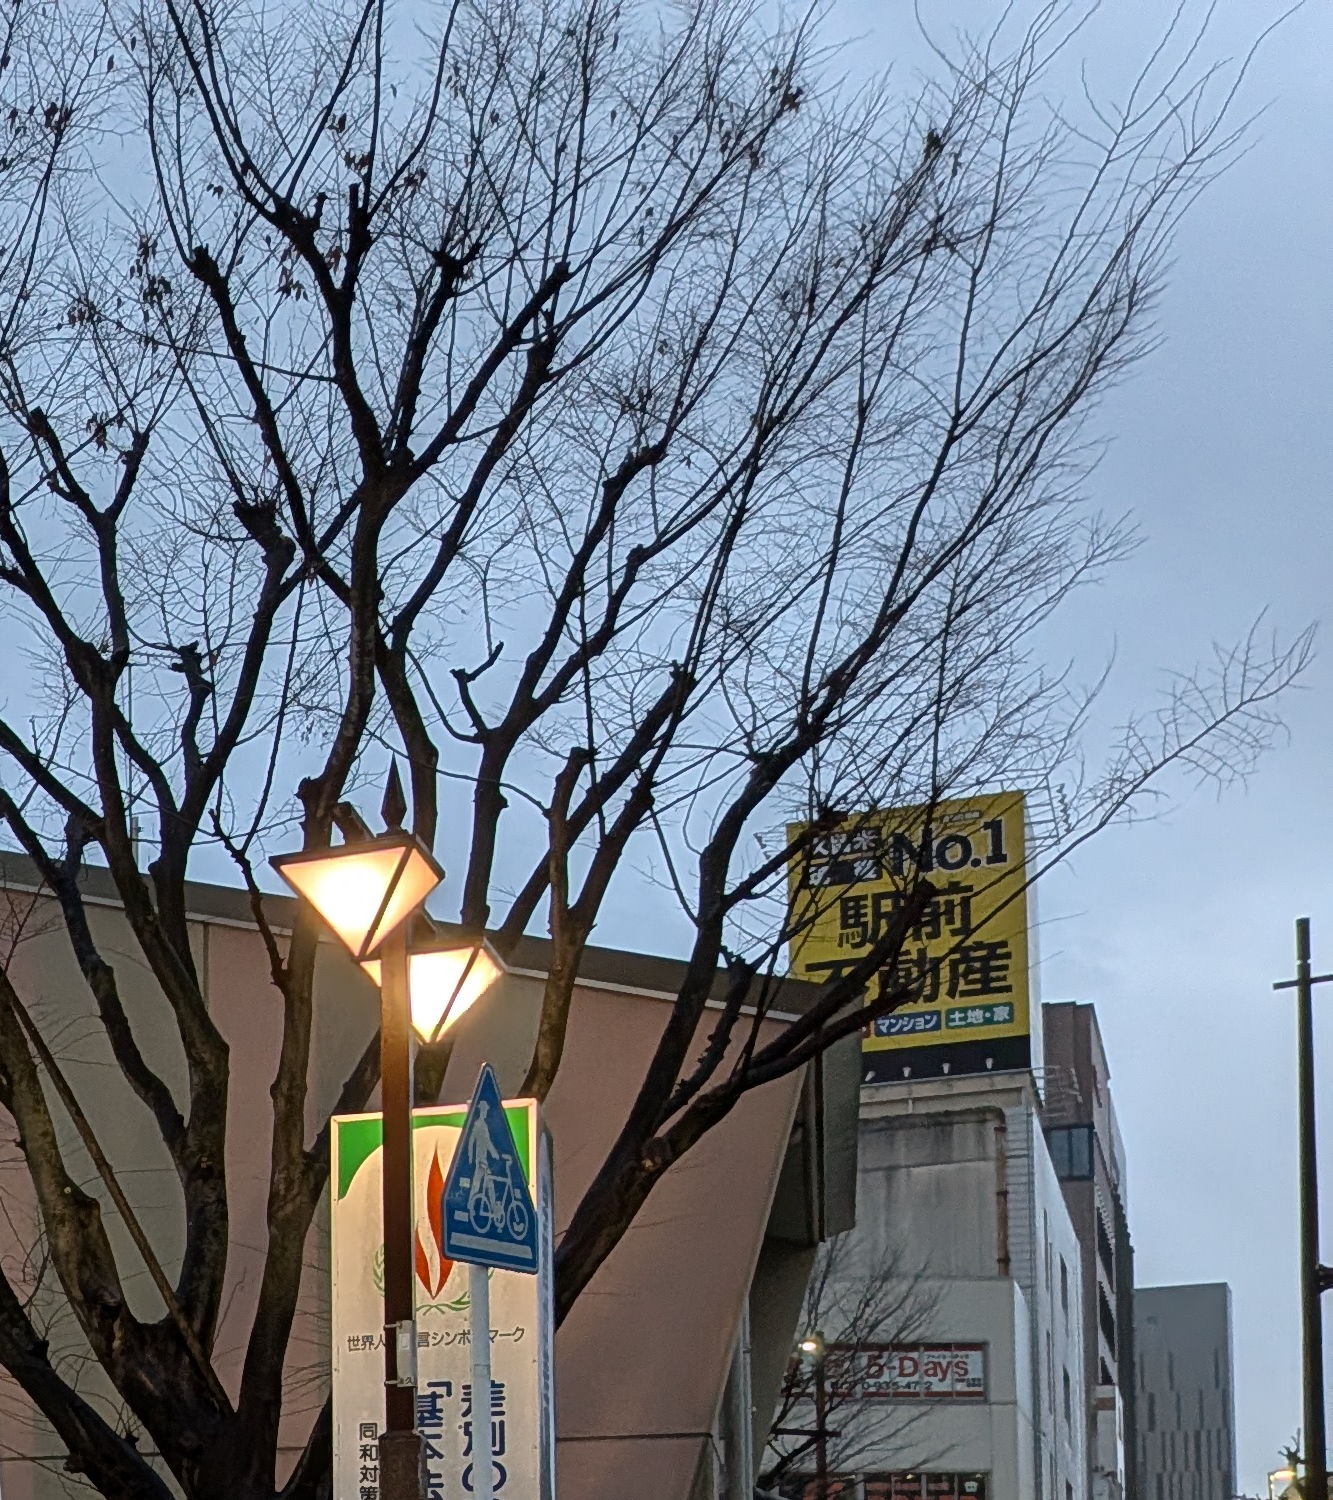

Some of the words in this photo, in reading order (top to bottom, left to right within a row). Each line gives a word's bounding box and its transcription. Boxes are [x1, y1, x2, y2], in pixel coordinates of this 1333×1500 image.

[877, 1014, 938, 1033] マンション
[346, 1326, 525, 1352] 世界人言シンボマーク
